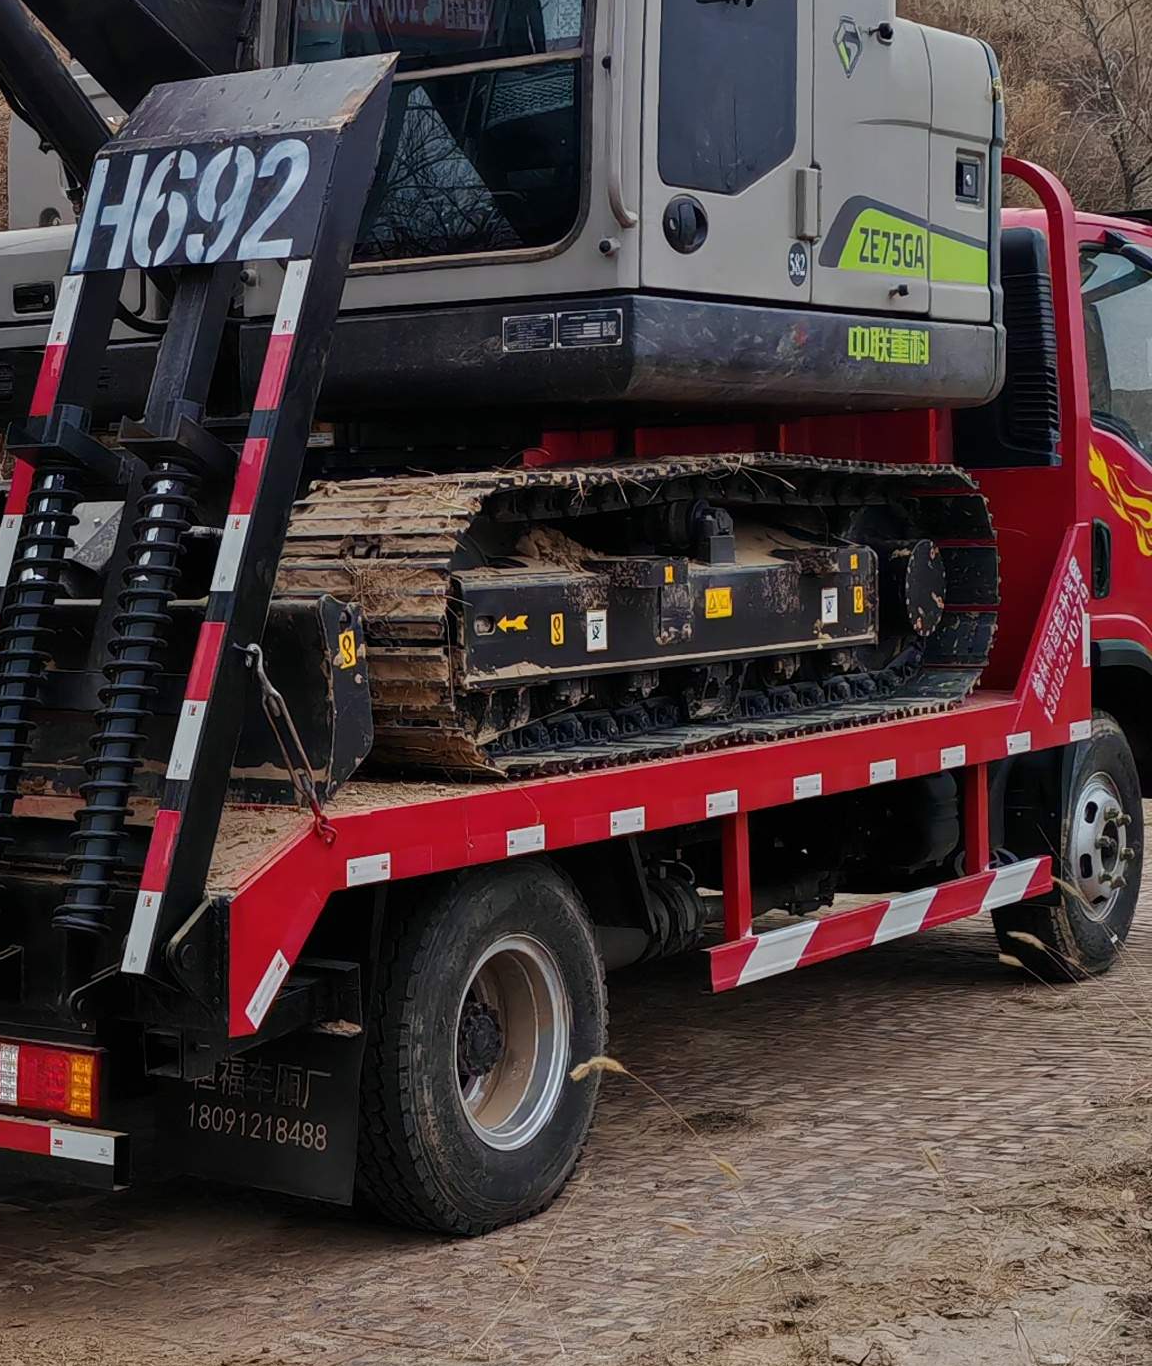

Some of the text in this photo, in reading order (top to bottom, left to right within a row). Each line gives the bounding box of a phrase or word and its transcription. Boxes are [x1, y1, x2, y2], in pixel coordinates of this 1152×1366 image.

[70, 139, 310, 272] H692
[789, 252, 807, 277] 582
[859, 228, 925, 270] ZE75GA
[848, 325, 930, 365] 中联重科
[188, 1101, 328, 1151] 18091218488
